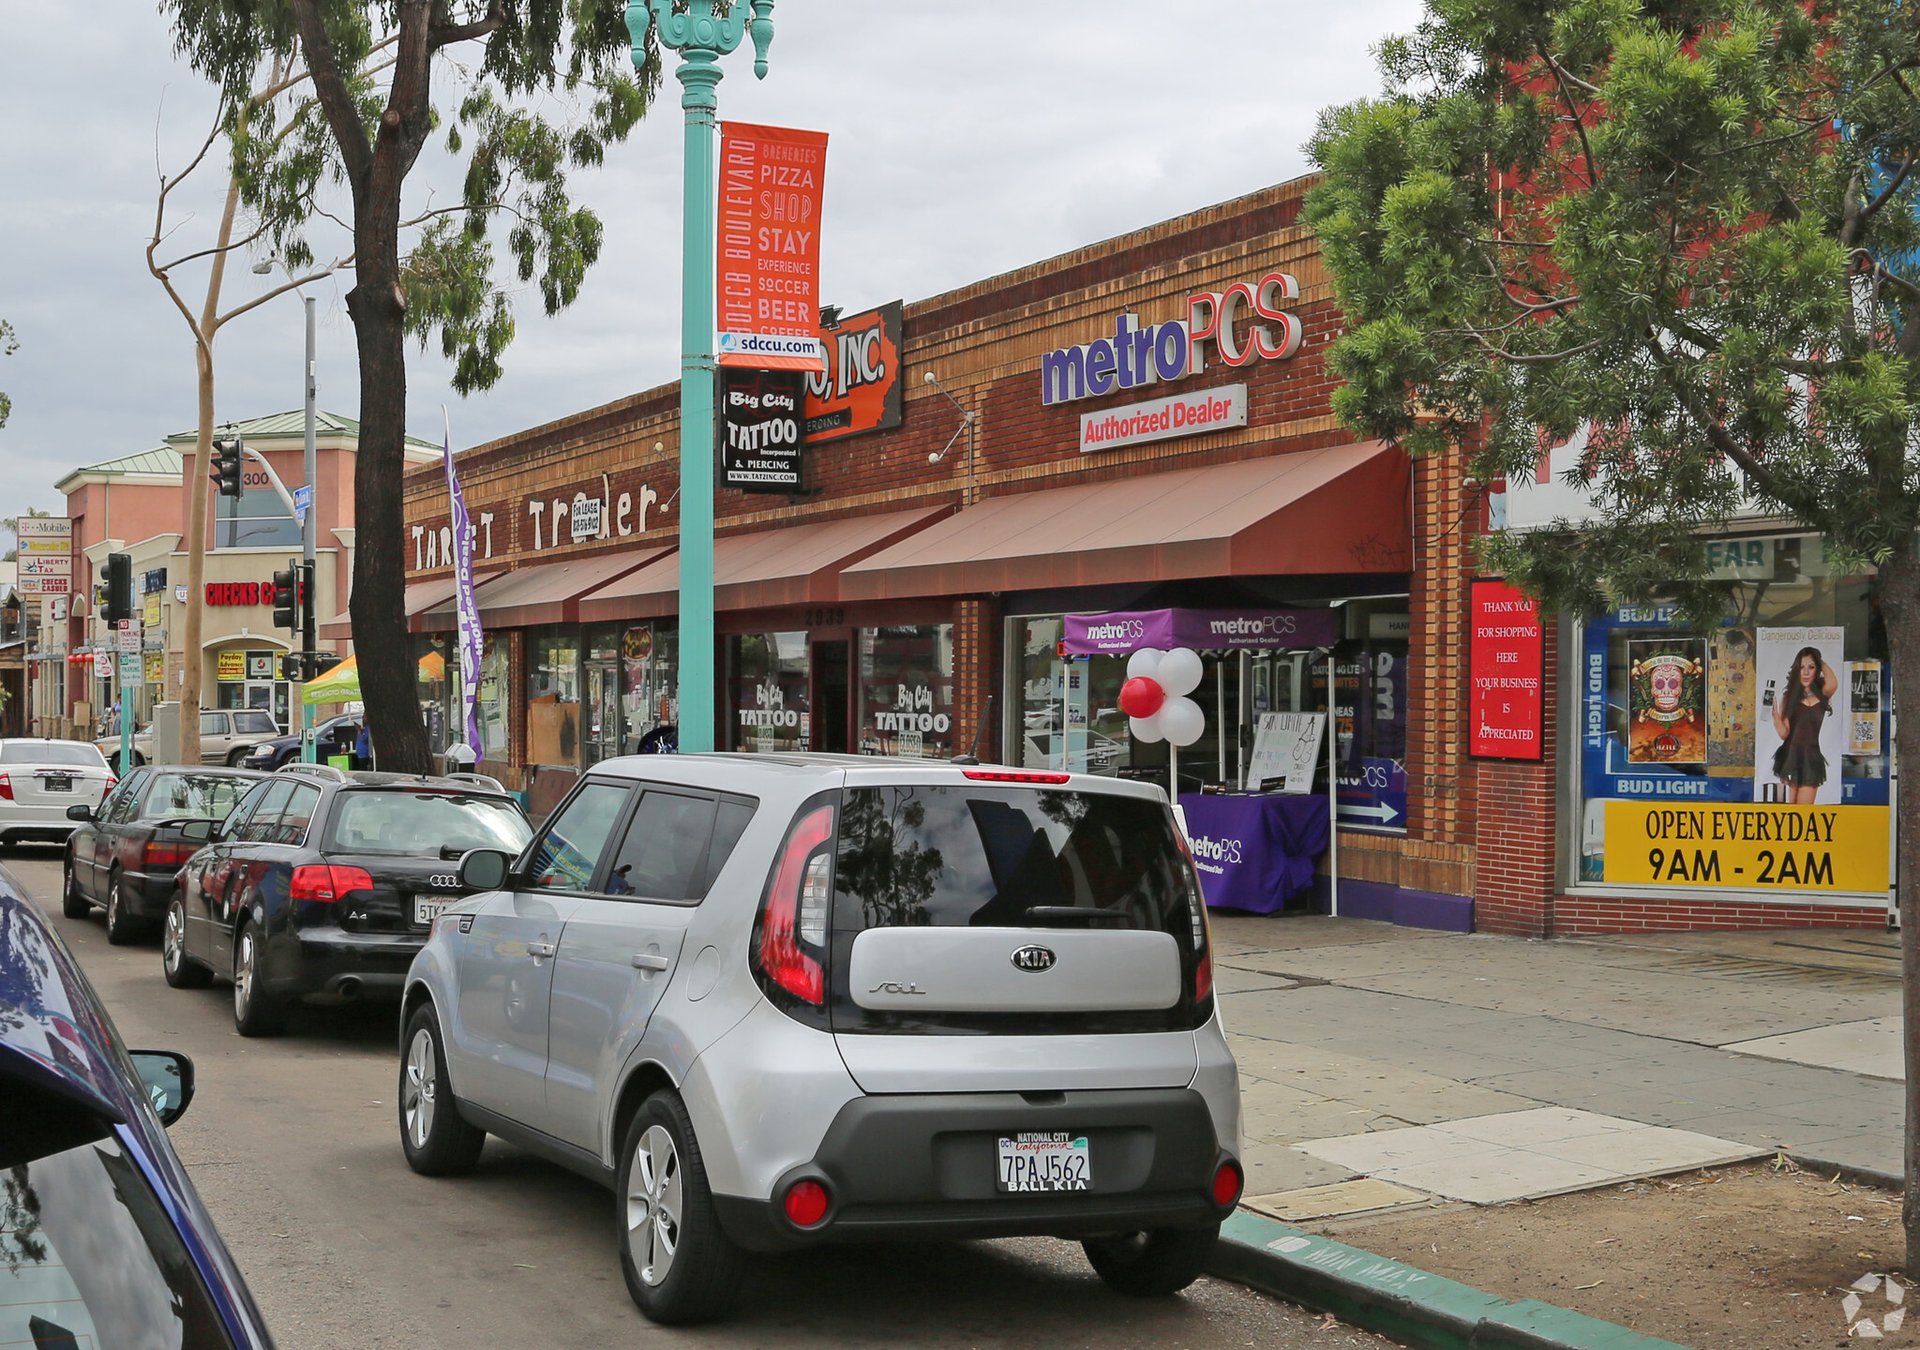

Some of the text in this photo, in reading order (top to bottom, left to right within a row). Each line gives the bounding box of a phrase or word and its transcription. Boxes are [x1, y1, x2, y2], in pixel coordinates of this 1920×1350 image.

[761, 165, 814, 189] PIZZA
[725, 139, 756, 260] BOULEVARD
[760, 190, 812, 224] SHOP
[758, 226, 811, 255] STAY
[758, 258, 810, 275] EXPERIENCE
[758, 277, 810, 296] SOCCER
[758, 298, 810, 323] BEER
[741, 337, 816, 354] sdccu.com
[1042, 272, 1301, 406] metroPCS
[837, 328, 886, 397] INC.
[729, 391, 795, 412] Big City
[1084, 396, 1232, 444] Authorized Dealer
[727, 417, 798, 451] TATTOO
[735, 459, 790, 470] & PIERCING
[729, 472, 797, 482] WWW.TAT2INC.COM
[461, 521, 473, 581] Dealer
[206, 582, 259, 606] CHECKS
[1483, 600, 1533, 613] THANK YOU
[1087, 619, 1144, 640] metroPCS
[1210, 616, 1296, 634] metroPCS
[1477, 627, 1537, 638] FOR SHOPPING
[1761, 631, 1806, 643] Dangerously
[1496, 652, 1518, 663] HERE
[1475, 677, 1538, 689] YOUR BUSINESS
[756, 684, 784, 713] Big City
[898, 683, 933, 715] Big City
[1502, 703, 1511, 714] IS
[1588, 653, 1602, 748] BUD LIGHT
[739, 709, 798, 727] TATTOO
[875, 711, 949, 733] TATTOO
[1478, 729, 1534, 741] APPRECIATED
[1617, 780, 1708, 795] BUD LIGHT
[1645, 810, 1837, 842] OPEN EVERYDAY
[1649, 848, 1722, 882] 9AM
[1756, 851, 1834, 885] 2AM
[349, 911, 367, 920] A4
[420, 904, 447, 920] 5TK
[1019, 950, 1051, 966] KIA
[1000, 1140, 1012, 1148] OCT
[1015, 1142, 1074, 1154] California
[1017, 1132, 1070, 1142] NATIONAL CITY
[1003, 1155, 1086, 1182] 7PAJ562
[1008, 1180, 1086, 1192] BALL KIA
[1305, 1247, 1427, 1290] MIN MAX
